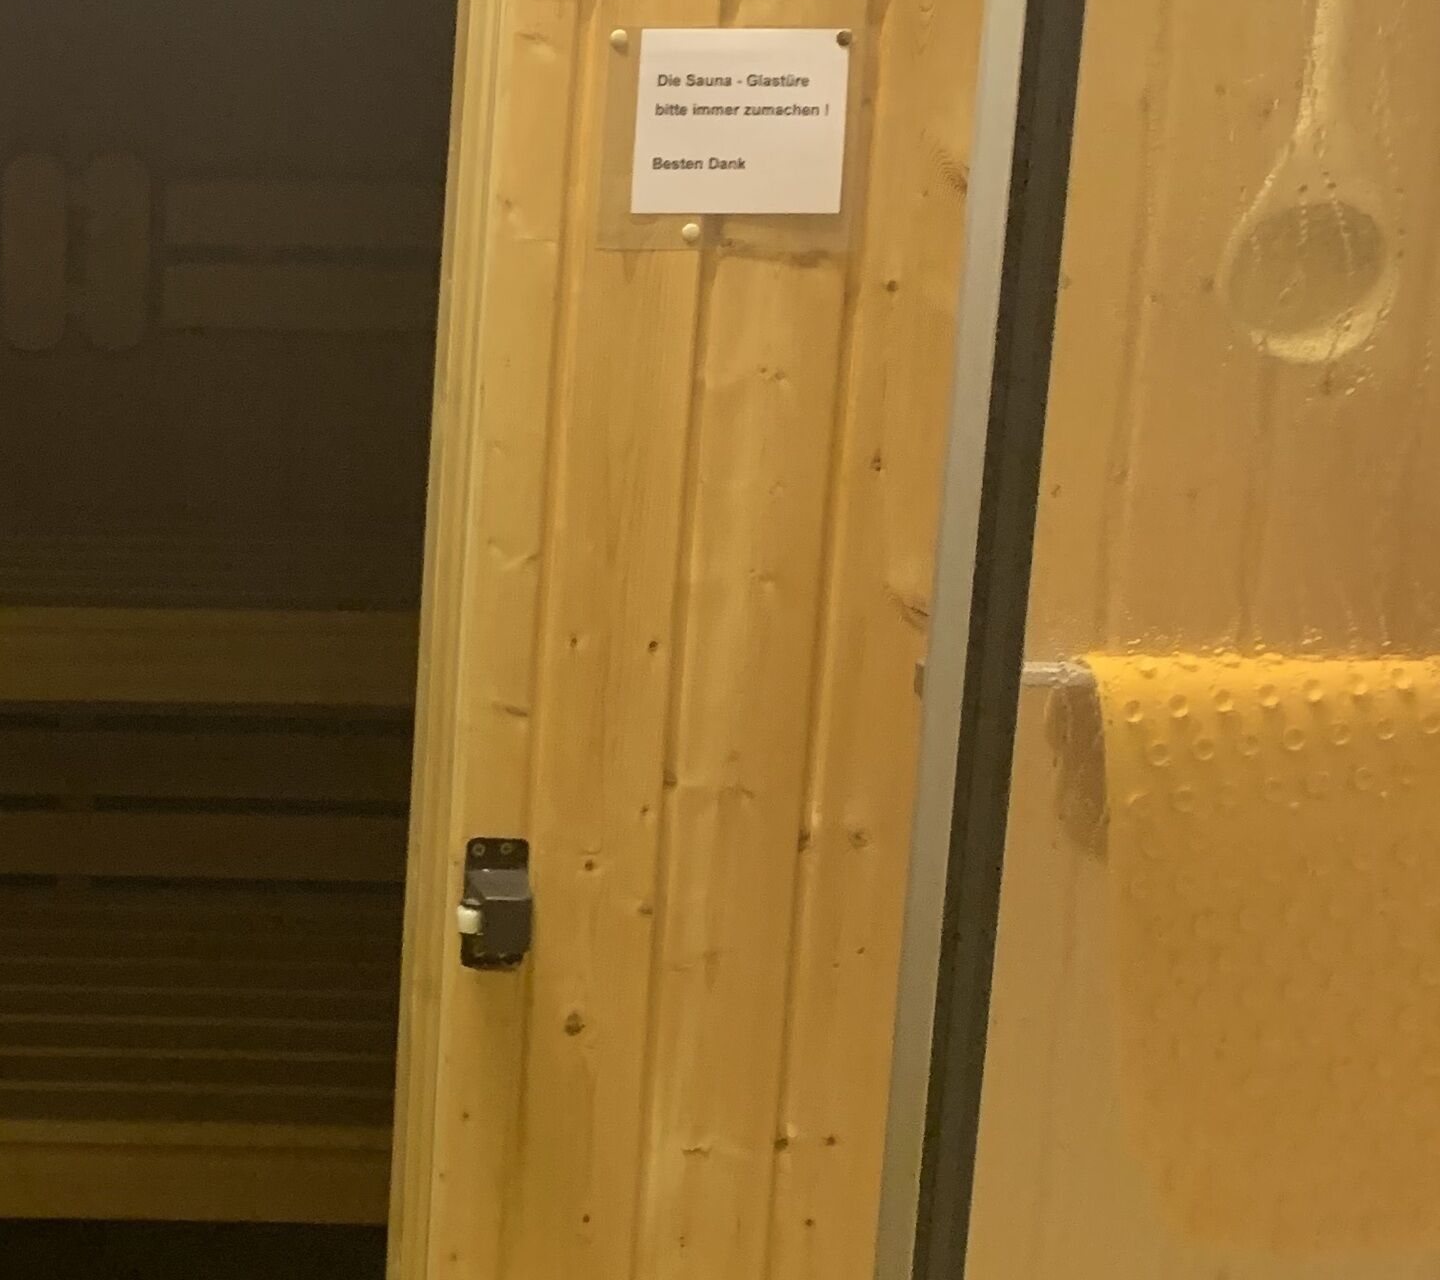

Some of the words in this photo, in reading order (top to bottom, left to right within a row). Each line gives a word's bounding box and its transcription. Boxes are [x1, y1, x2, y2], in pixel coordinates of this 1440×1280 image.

[657, 74, 681, 87] Die
[686, 74, 732, 87] Sauna
[746, 73, 810, 87] Glastüre
[655, 103, 688, 116] bitte
[692, 103, 740, 116] immer
[743, 104, 820, 116] zumachen
[652, 157, 704, 170] Besten
[708, 157, 746, 170] Dank
